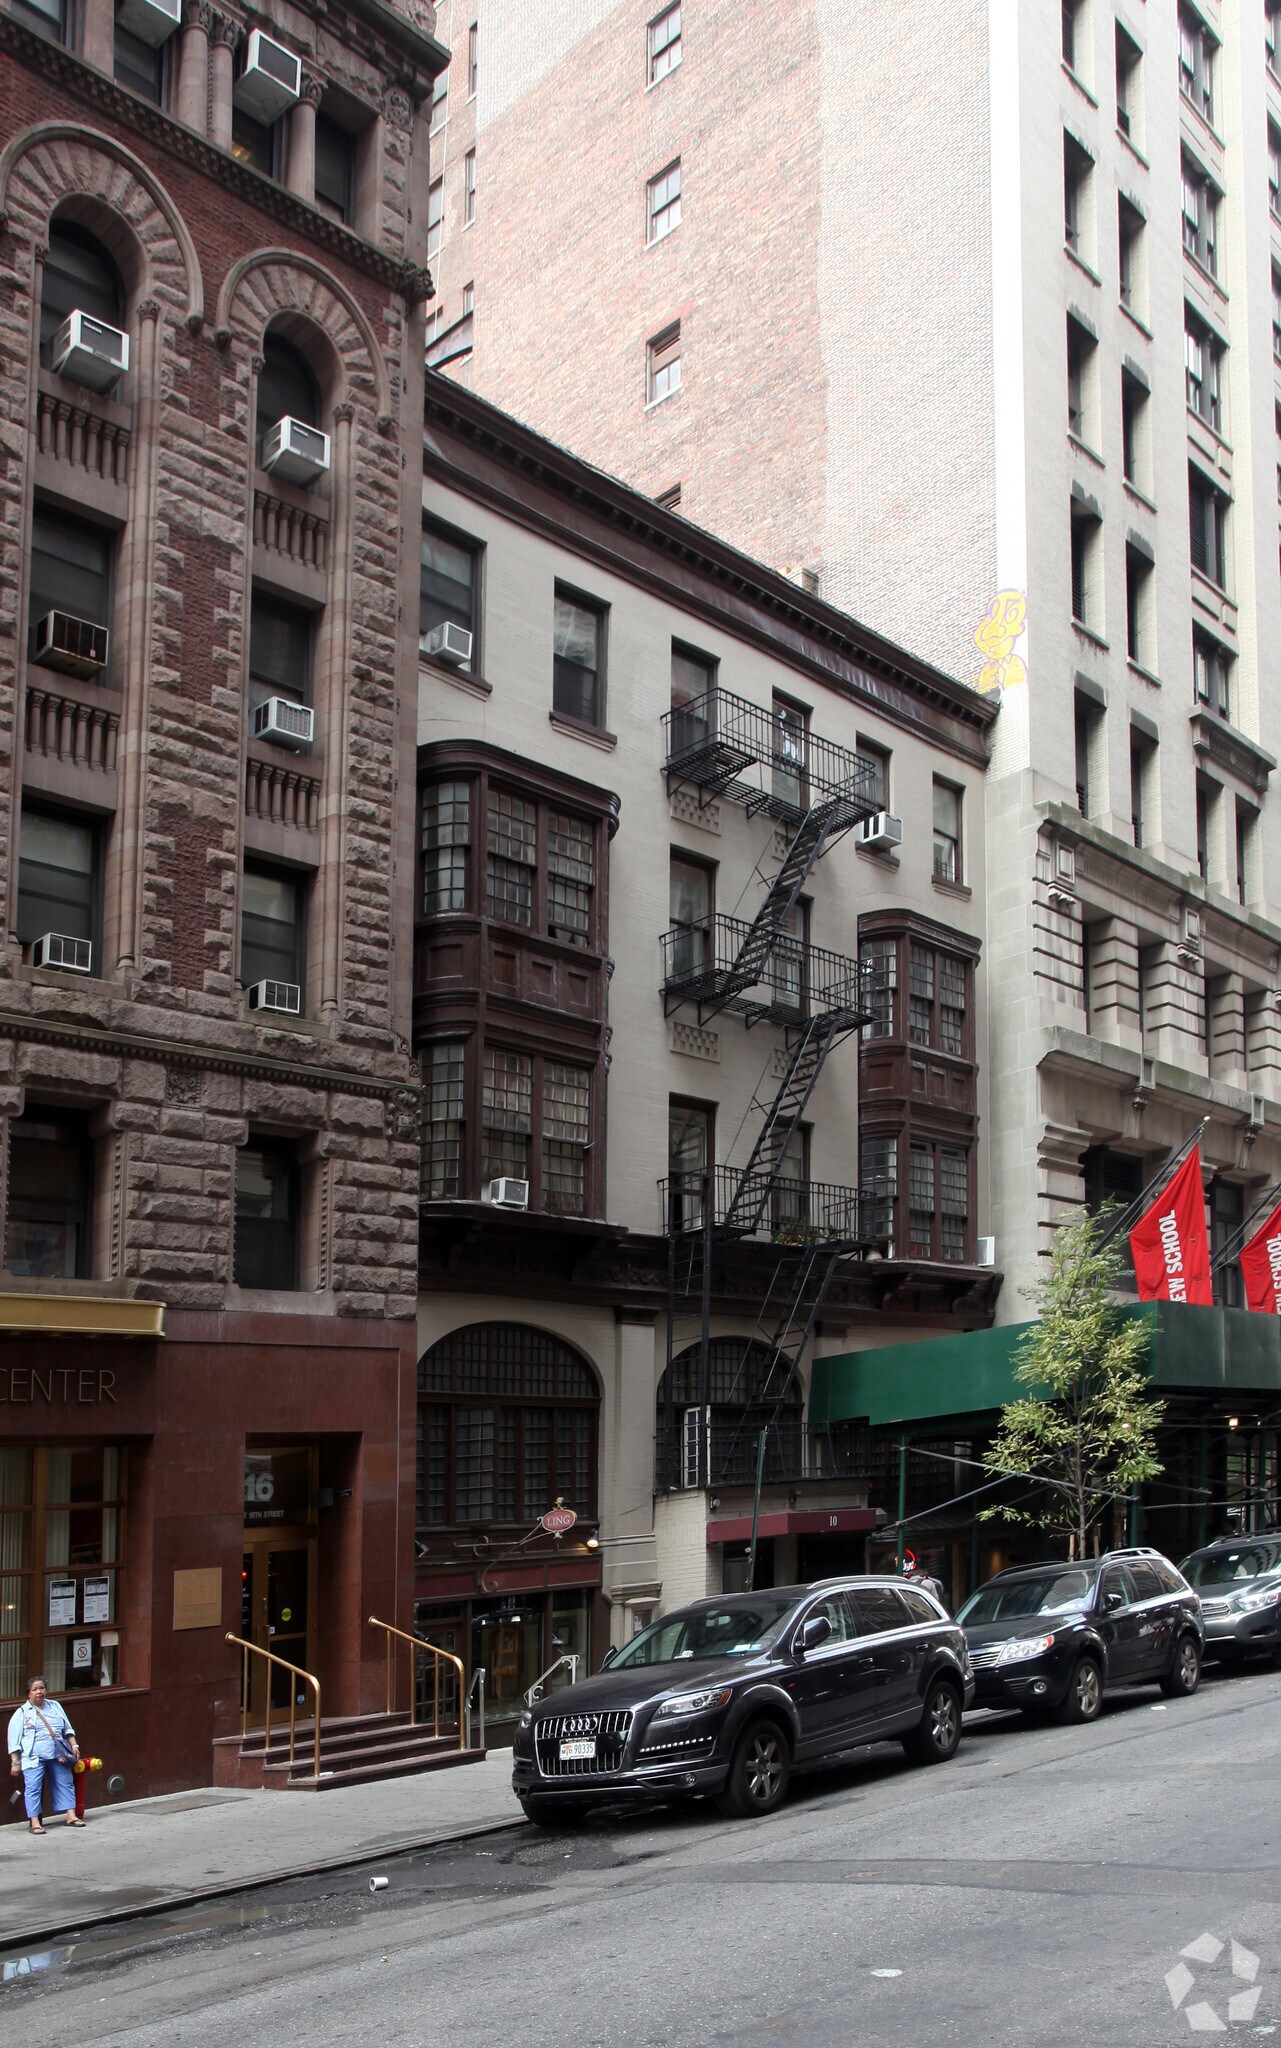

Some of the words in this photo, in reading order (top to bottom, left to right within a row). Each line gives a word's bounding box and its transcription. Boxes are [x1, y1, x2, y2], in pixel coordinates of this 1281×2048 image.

[1159, 1210, 1184, 1274] SCHOOL
[1168, 1277, 1187, 1303] EW
[0, 1368, 118, 1402] ENTER
[246, 1472, 274, 1501] 16
[263, 1509, 285, 1518] STREET
[547, 1515, 571, 1526] LING
[829, 1515, 838, 1526] 10
